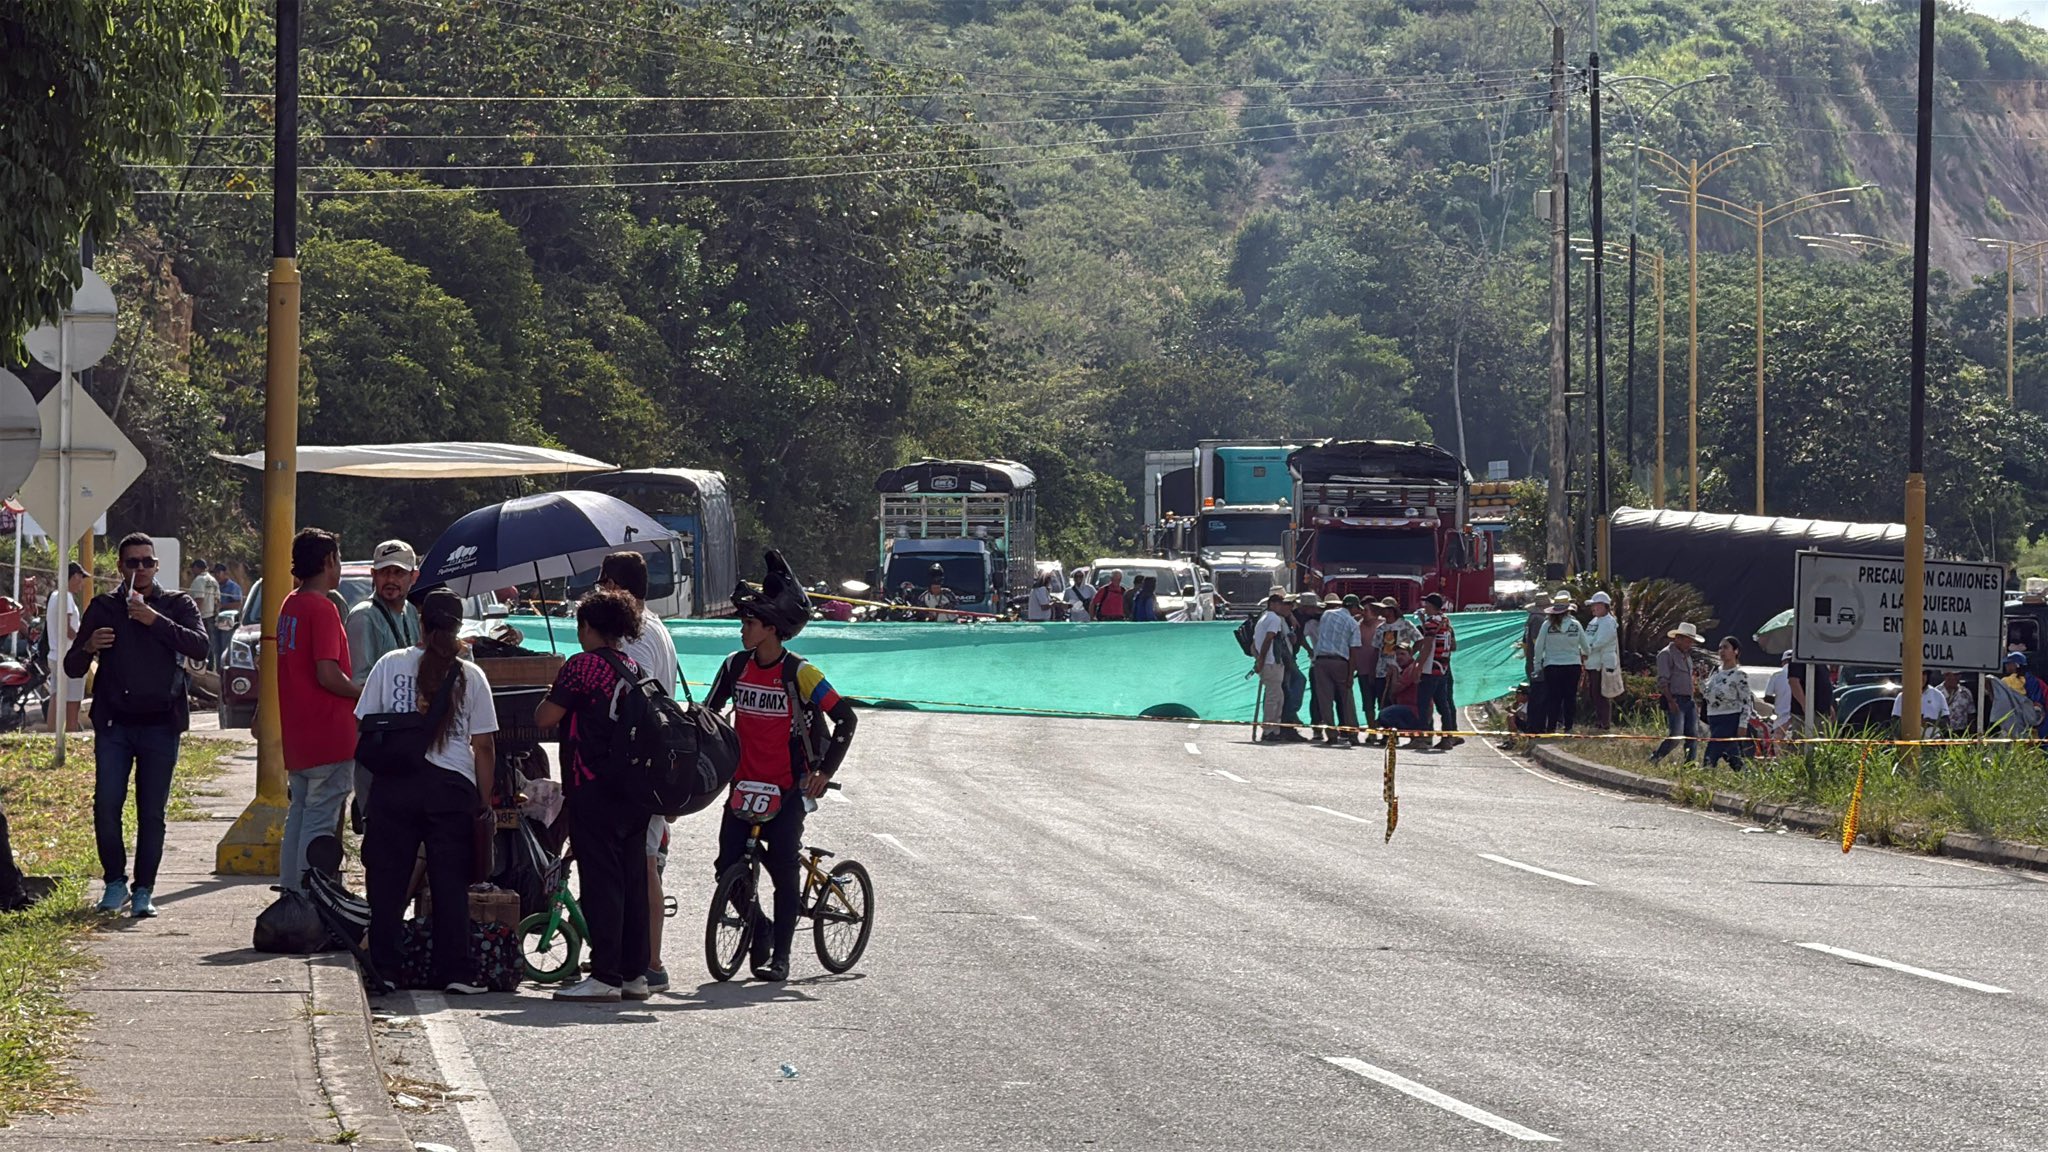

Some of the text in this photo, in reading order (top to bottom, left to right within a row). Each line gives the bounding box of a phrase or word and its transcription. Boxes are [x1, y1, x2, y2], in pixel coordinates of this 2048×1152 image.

[1858, 566, 1998, 590] PRECAUN CAMIONES
[1880, 593, 1972, 613] A LA QUIERDA
[1883, 616, 1967, 637] ENTDA A LA
[1899, 641, 1954, 661] CULA
[759, 693, 786, 710] BMX
[741, 793, 771, 813] 16
